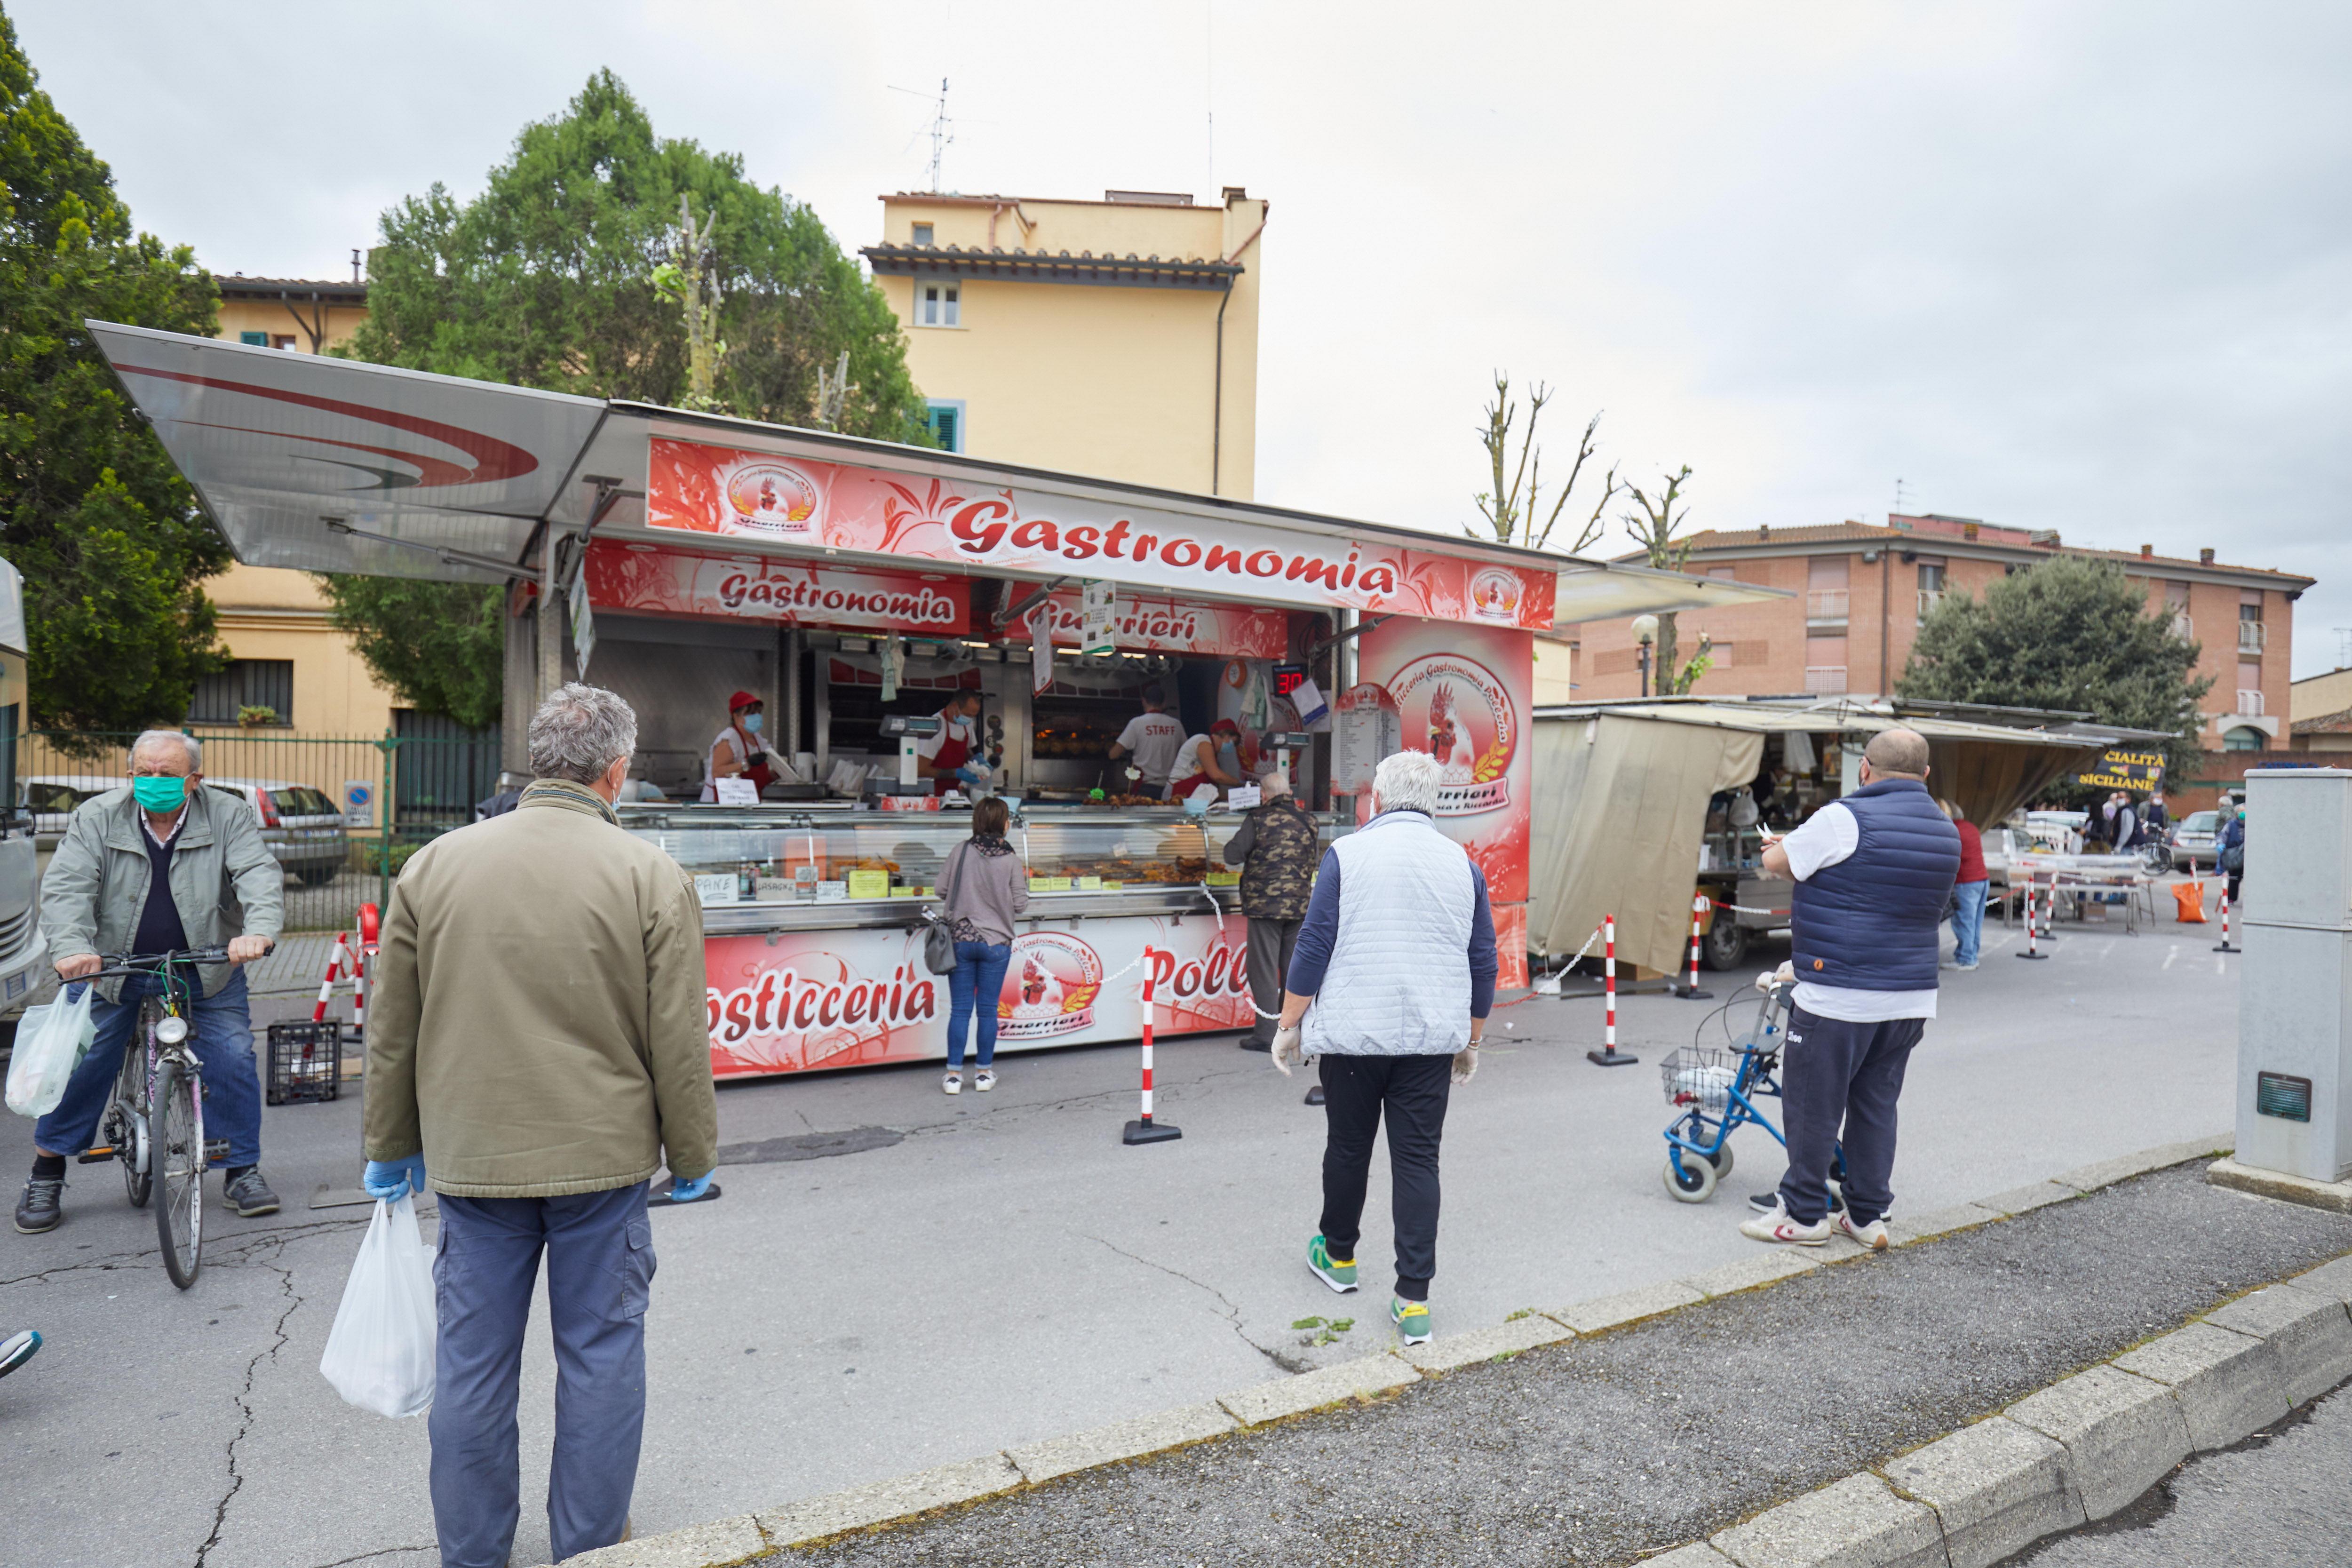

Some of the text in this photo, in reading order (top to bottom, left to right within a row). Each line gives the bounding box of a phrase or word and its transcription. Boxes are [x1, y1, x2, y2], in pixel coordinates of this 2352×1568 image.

[951, 500, 1397, 594] Gastronomia
[720, 573, 951, 619] Gastronomia
[1027, 603, 1195, 639] Gurieri
[1279, 673, 1303, 694] 30
[1427, 662, 1484, 688] Gastronomia
[1145, 725, 1175, 736] STAFF
[1463, 798, 1505, 809] Riccardo
[696, 878, 730, 891] PANE
[758, 883, 794, 891] LASAGNE
